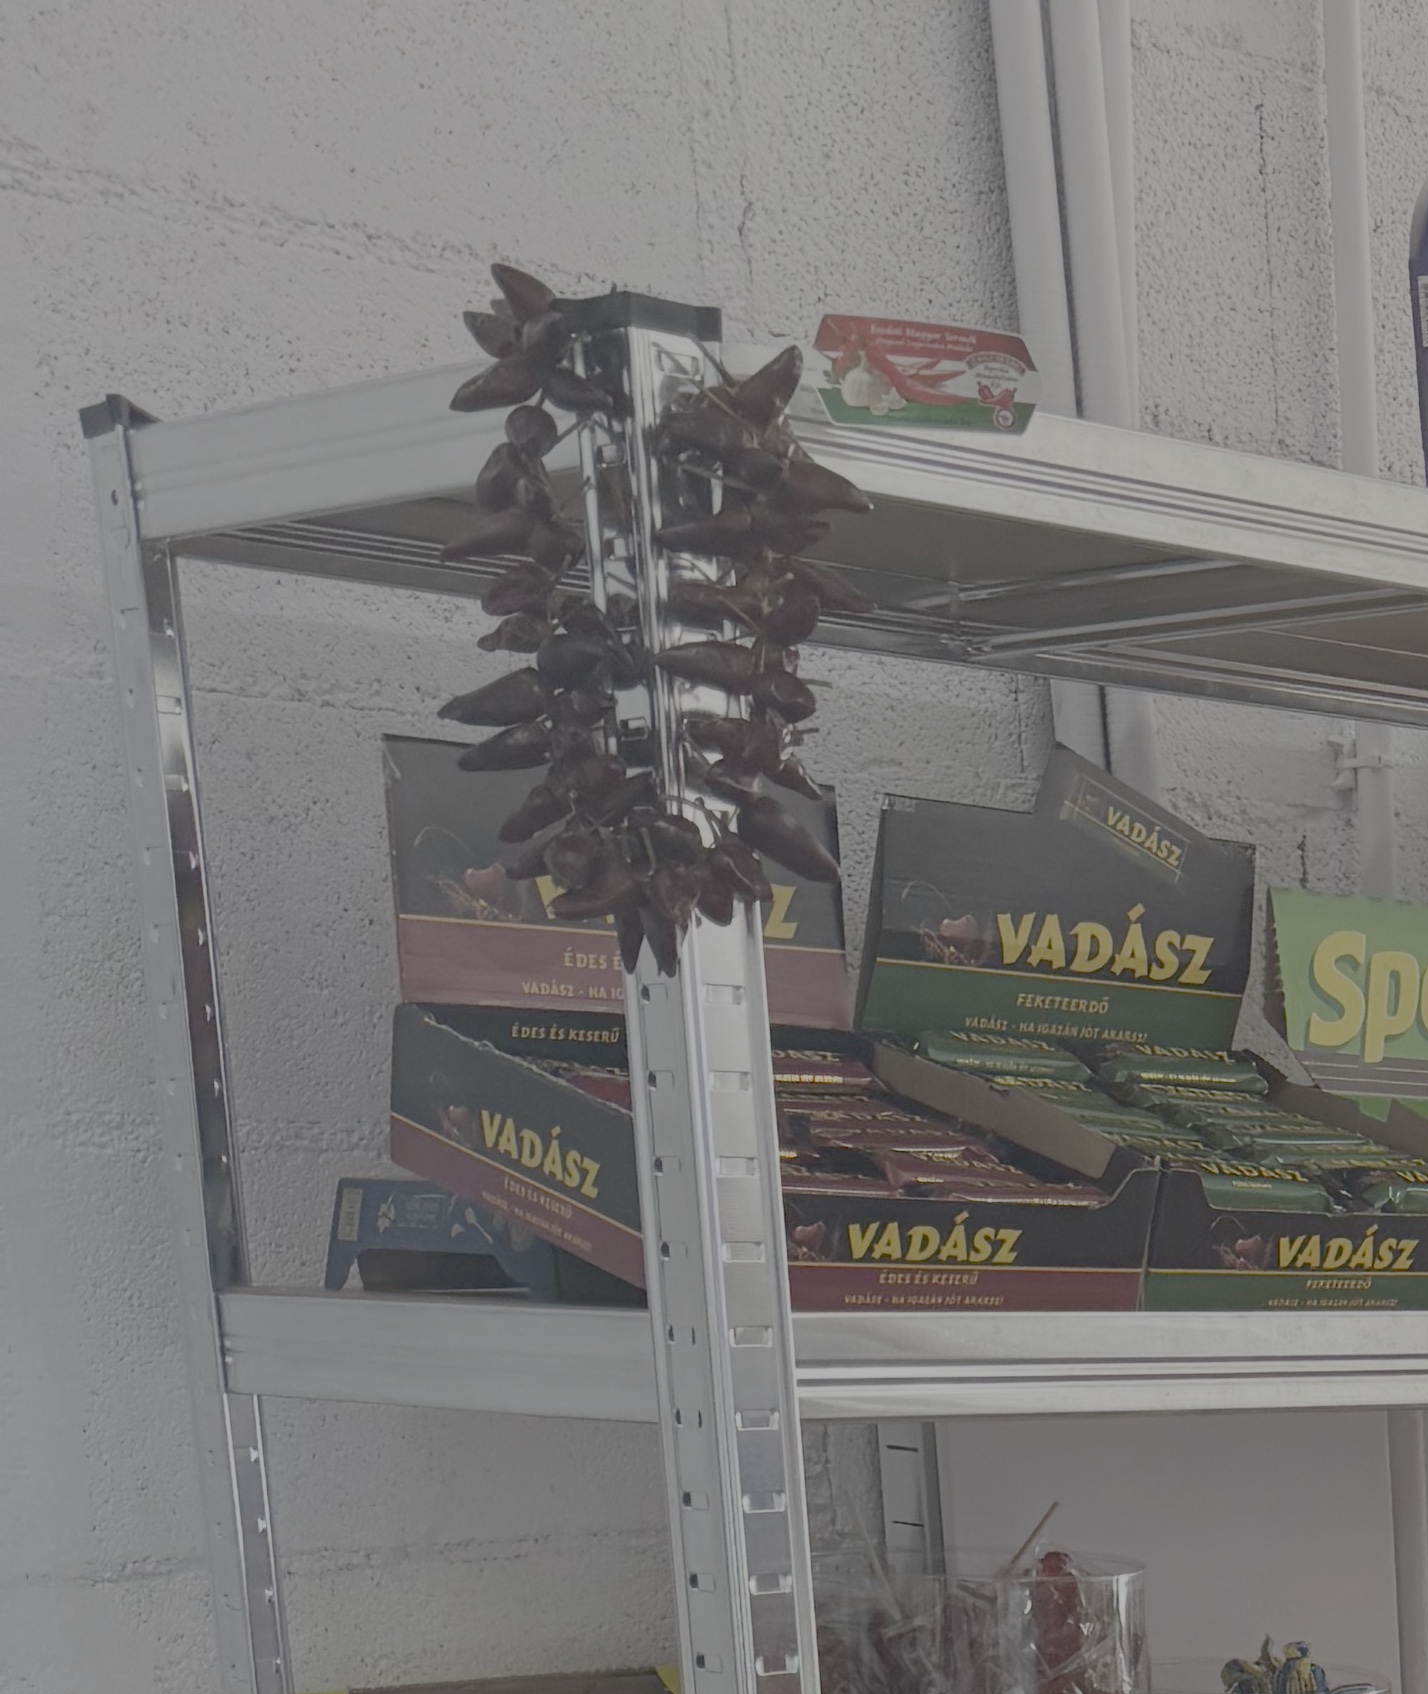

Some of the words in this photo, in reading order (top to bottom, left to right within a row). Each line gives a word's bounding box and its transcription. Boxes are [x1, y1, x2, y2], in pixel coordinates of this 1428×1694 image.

[1106, 804, 1182, 868] VADÁSZ
[997, 903, 1214, 984] VADÁSZ
[1016, 993, 1110, 1015] FEKETEERDŐ
[511, 1023, 547, 1041] ÉDES
[549, 1022, 567, 1041] ÉS
[568, 1026, 621, 1044] KESERŰ
[481, 1109, 601, 1199] VADÁSZ
[848, 1209, 1023, 1264] VADÁSZ
[1279, 1223, 1421, 1270] VADÁSZ
